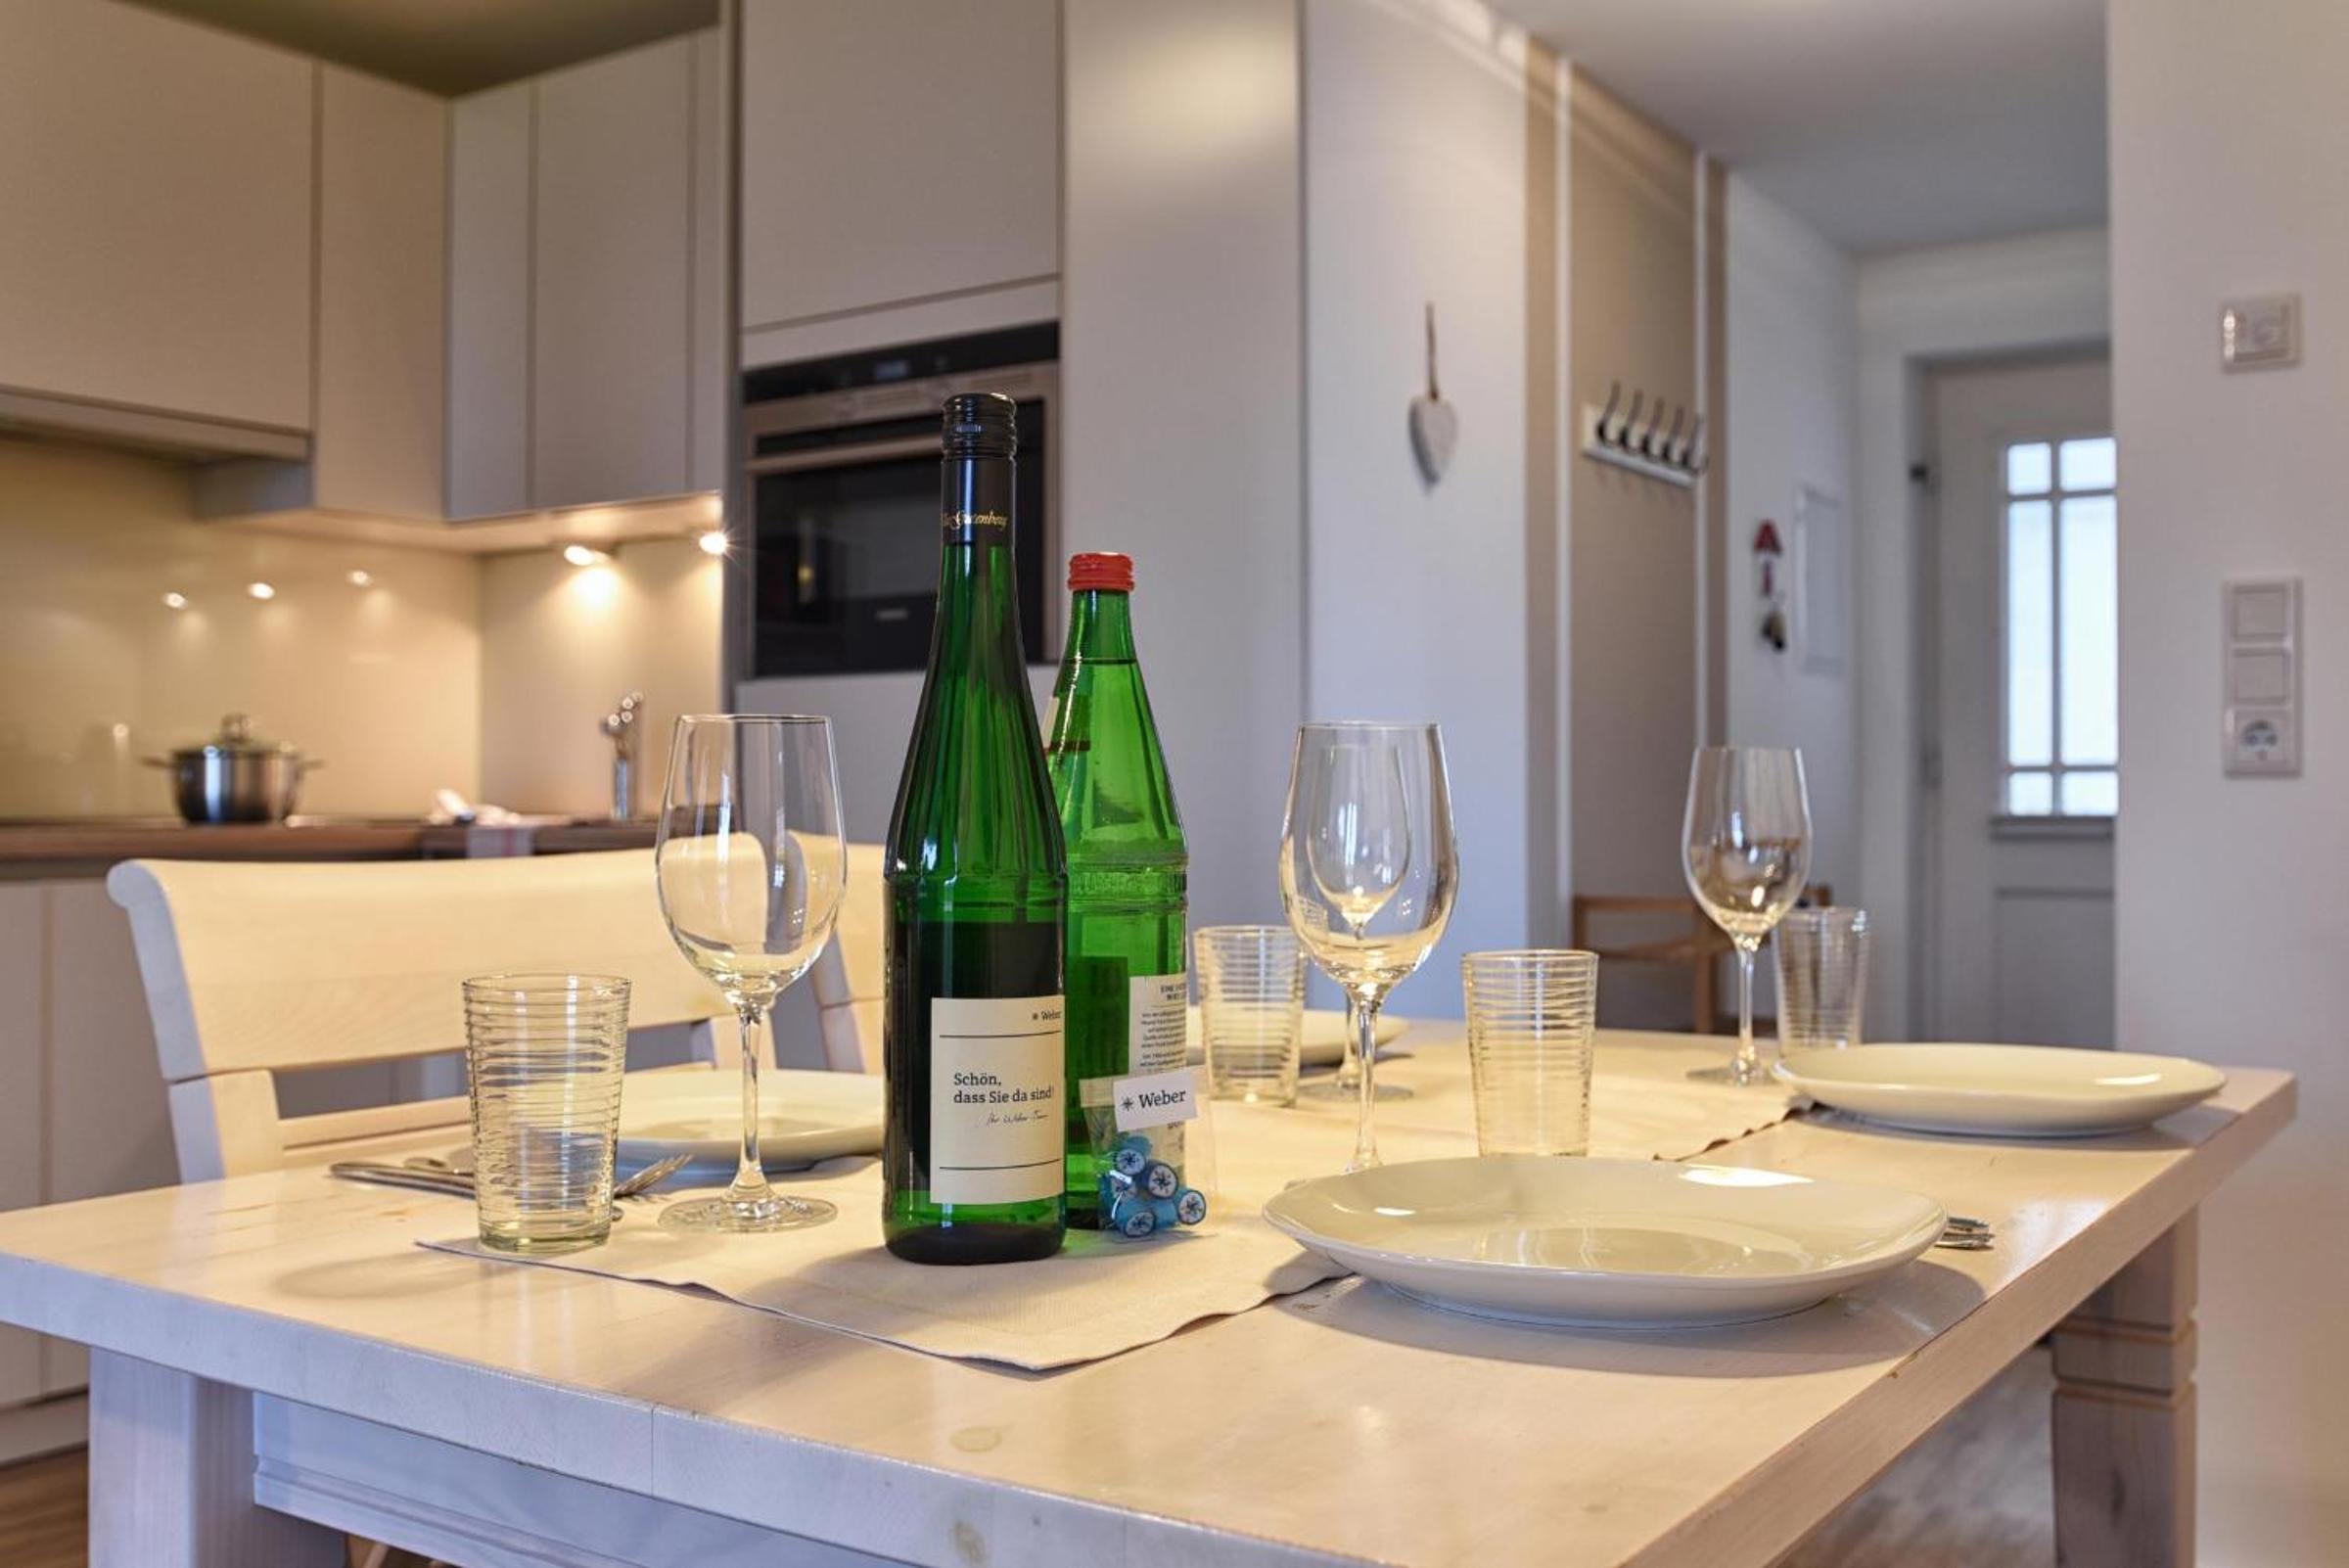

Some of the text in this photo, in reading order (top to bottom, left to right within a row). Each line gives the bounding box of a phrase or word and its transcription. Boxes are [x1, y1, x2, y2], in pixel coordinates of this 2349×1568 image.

[953, 1072, 1002, 1086] Schön,
[953, 1089, 986, 1104] dass
[989, 1089, 1009, 1104] Sie
[1012, 1087, 1028, 1102] da
[1138, 1088, 1186, 1109] Weber
